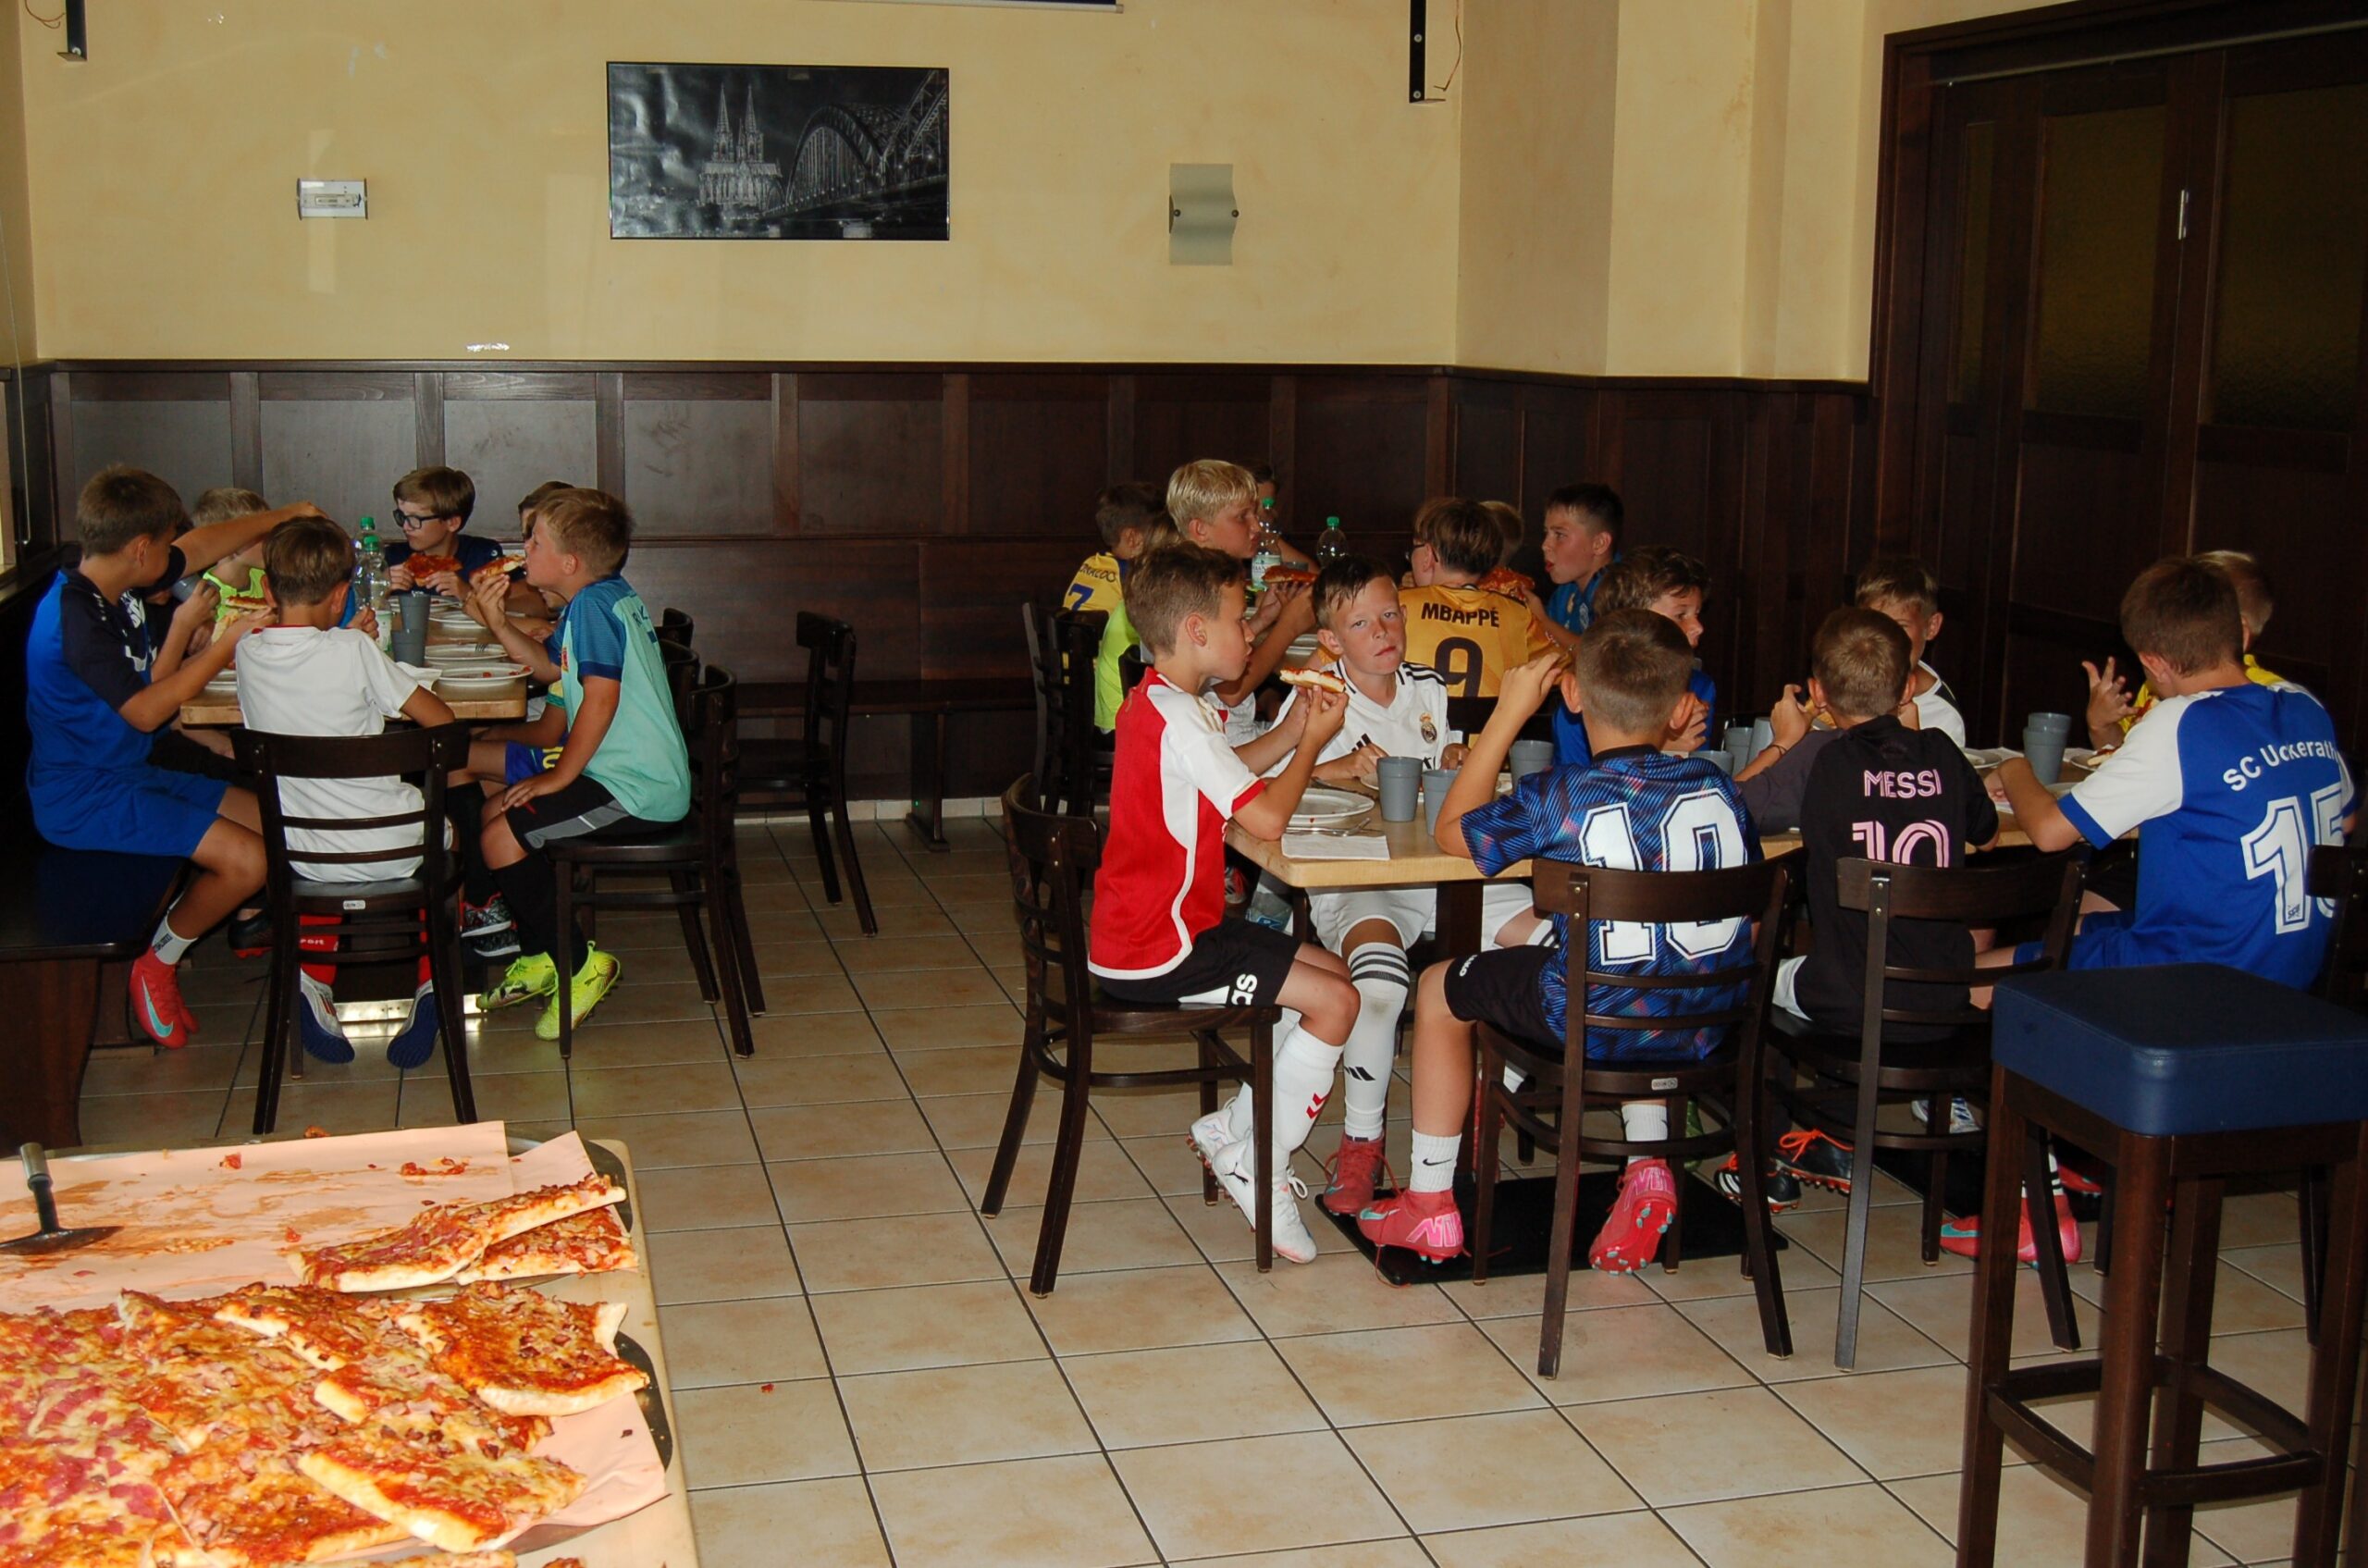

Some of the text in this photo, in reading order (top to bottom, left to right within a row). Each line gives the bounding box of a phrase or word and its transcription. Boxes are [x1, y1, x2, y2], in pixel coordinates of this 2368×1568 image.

[1068, 584, 1094, 611] 7
[1421, 602, 1499, 627] MBAPPÉ
[1435, 636, 1483, 697] 9
[1864, 770, 1942, 798] MESSI
[2223, 740, 2338, 791] SC Uckerath
[1852, 819, 1950, 868] 10
[2239, 781, 2346, 934] 15
[1579, 788, 1747, 965] 10
